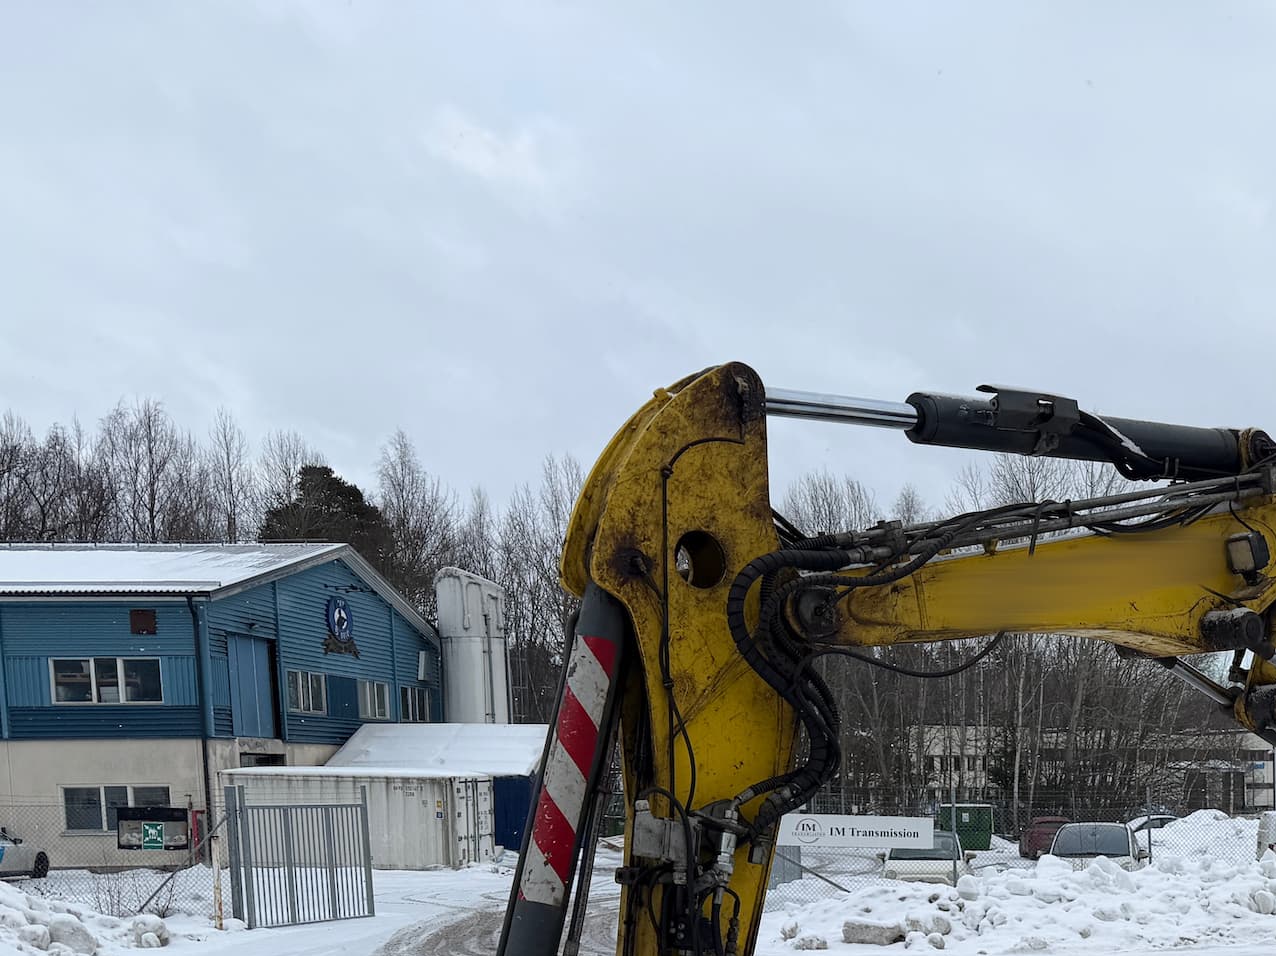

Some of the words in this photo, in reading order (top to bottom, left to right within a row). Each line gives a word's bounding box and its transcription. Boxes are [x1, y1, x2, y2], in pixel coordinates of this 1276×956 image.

[802, 823, 816, 831] IM
[829, 827, 846, 837] IM
[848, 827, 919, 839] Transmission
